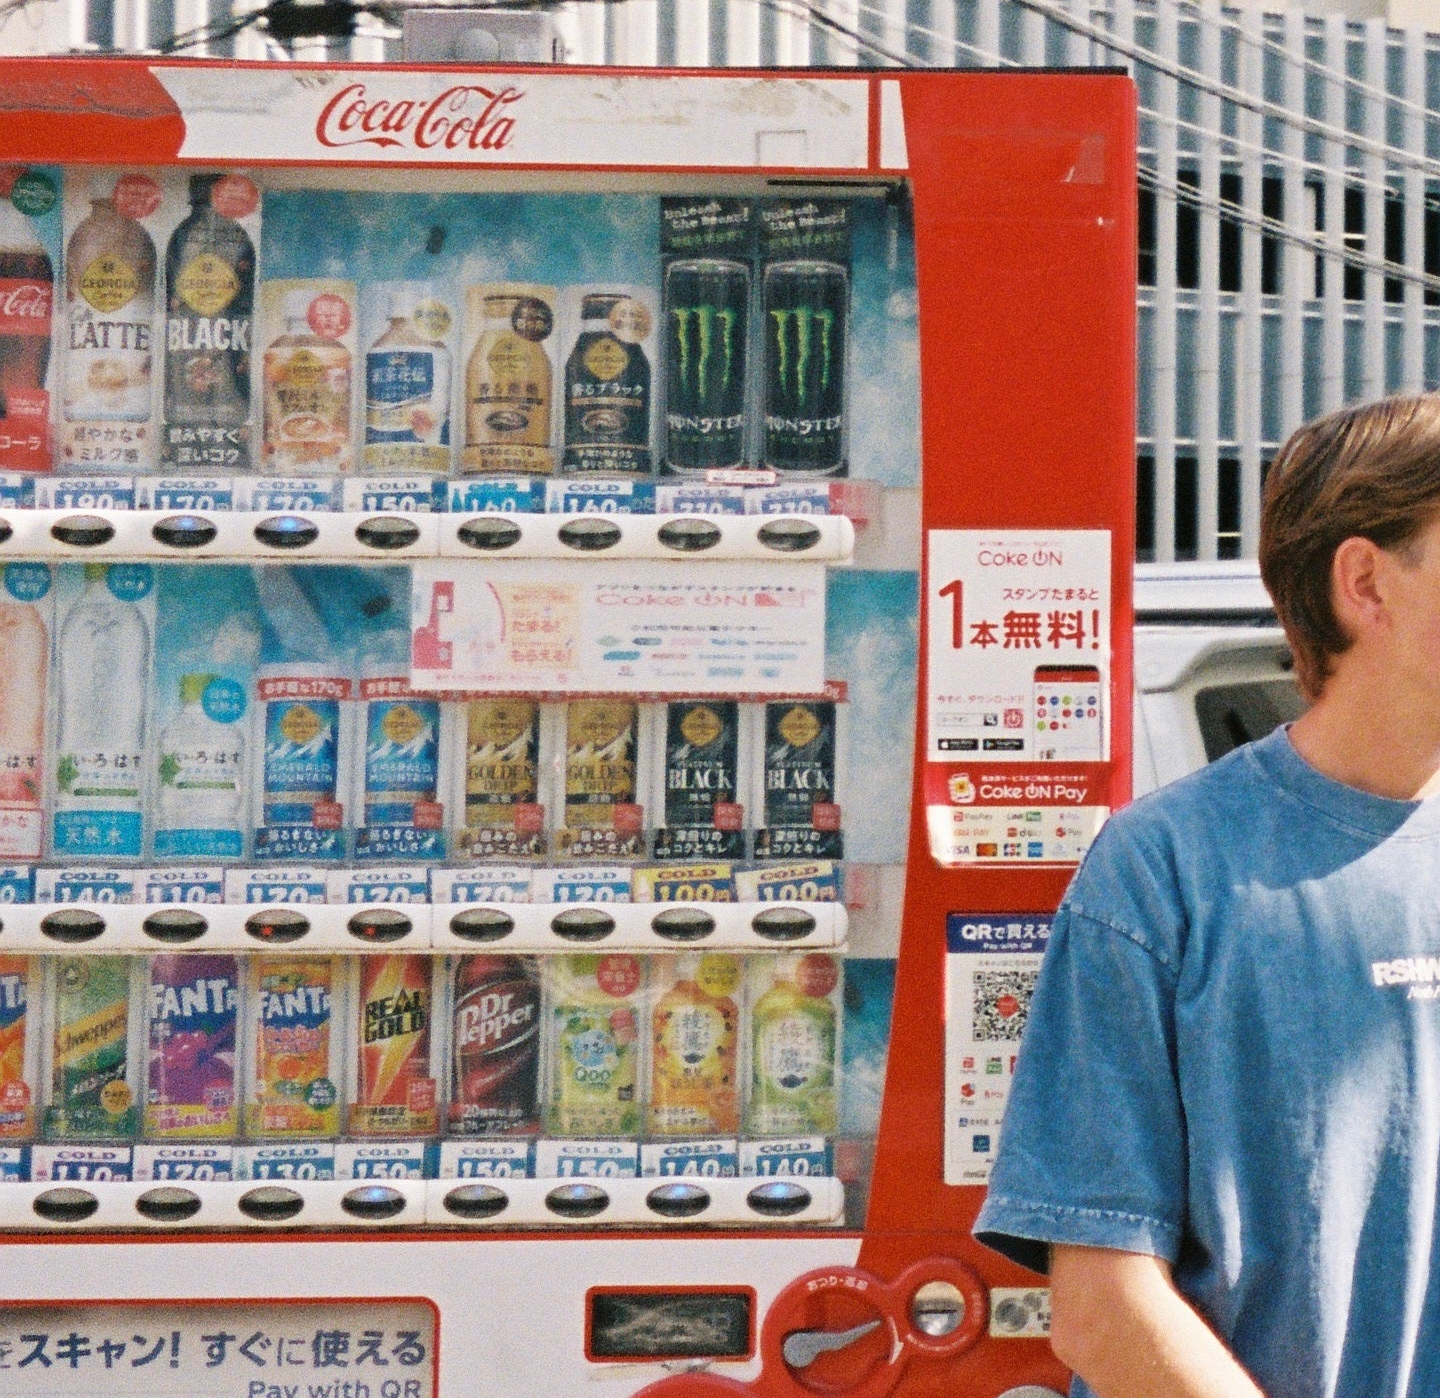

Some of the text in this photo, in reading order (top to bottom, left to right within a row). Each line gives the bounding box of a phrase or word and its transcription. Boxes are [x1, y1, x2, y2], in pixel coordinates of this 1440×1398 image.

[316, 83, 525, 150] Coca-Cola
[71, 322, 150, 349] LATTE
[168, 318, 249, 351] BLACK
[366, 482, 418, 490] COLD
[568, 484, 620, 492] COLD
[978, 550, 1063, 567] Coke ON
[1003, 588, 1099, 601] スタンプたまると
[669, 769, 731, 789] BLACK
[768, 769, 829, 789] BLACK
[980, 783, 1087, 803] Coke ON Pay
[60, 873, 120, 881] COLD
[658, 869, 716, 879] COLD
[760, 867, 819, 881] COLD
[478, 993, 514, 1015] Dr
[458, 1005, 532, 1045] Pepper
[664, 1145, 723, 1154] COLD
[759, 1143, 811, 1152] COLD
[202, 1330, 427, 1368] すぐに使える
